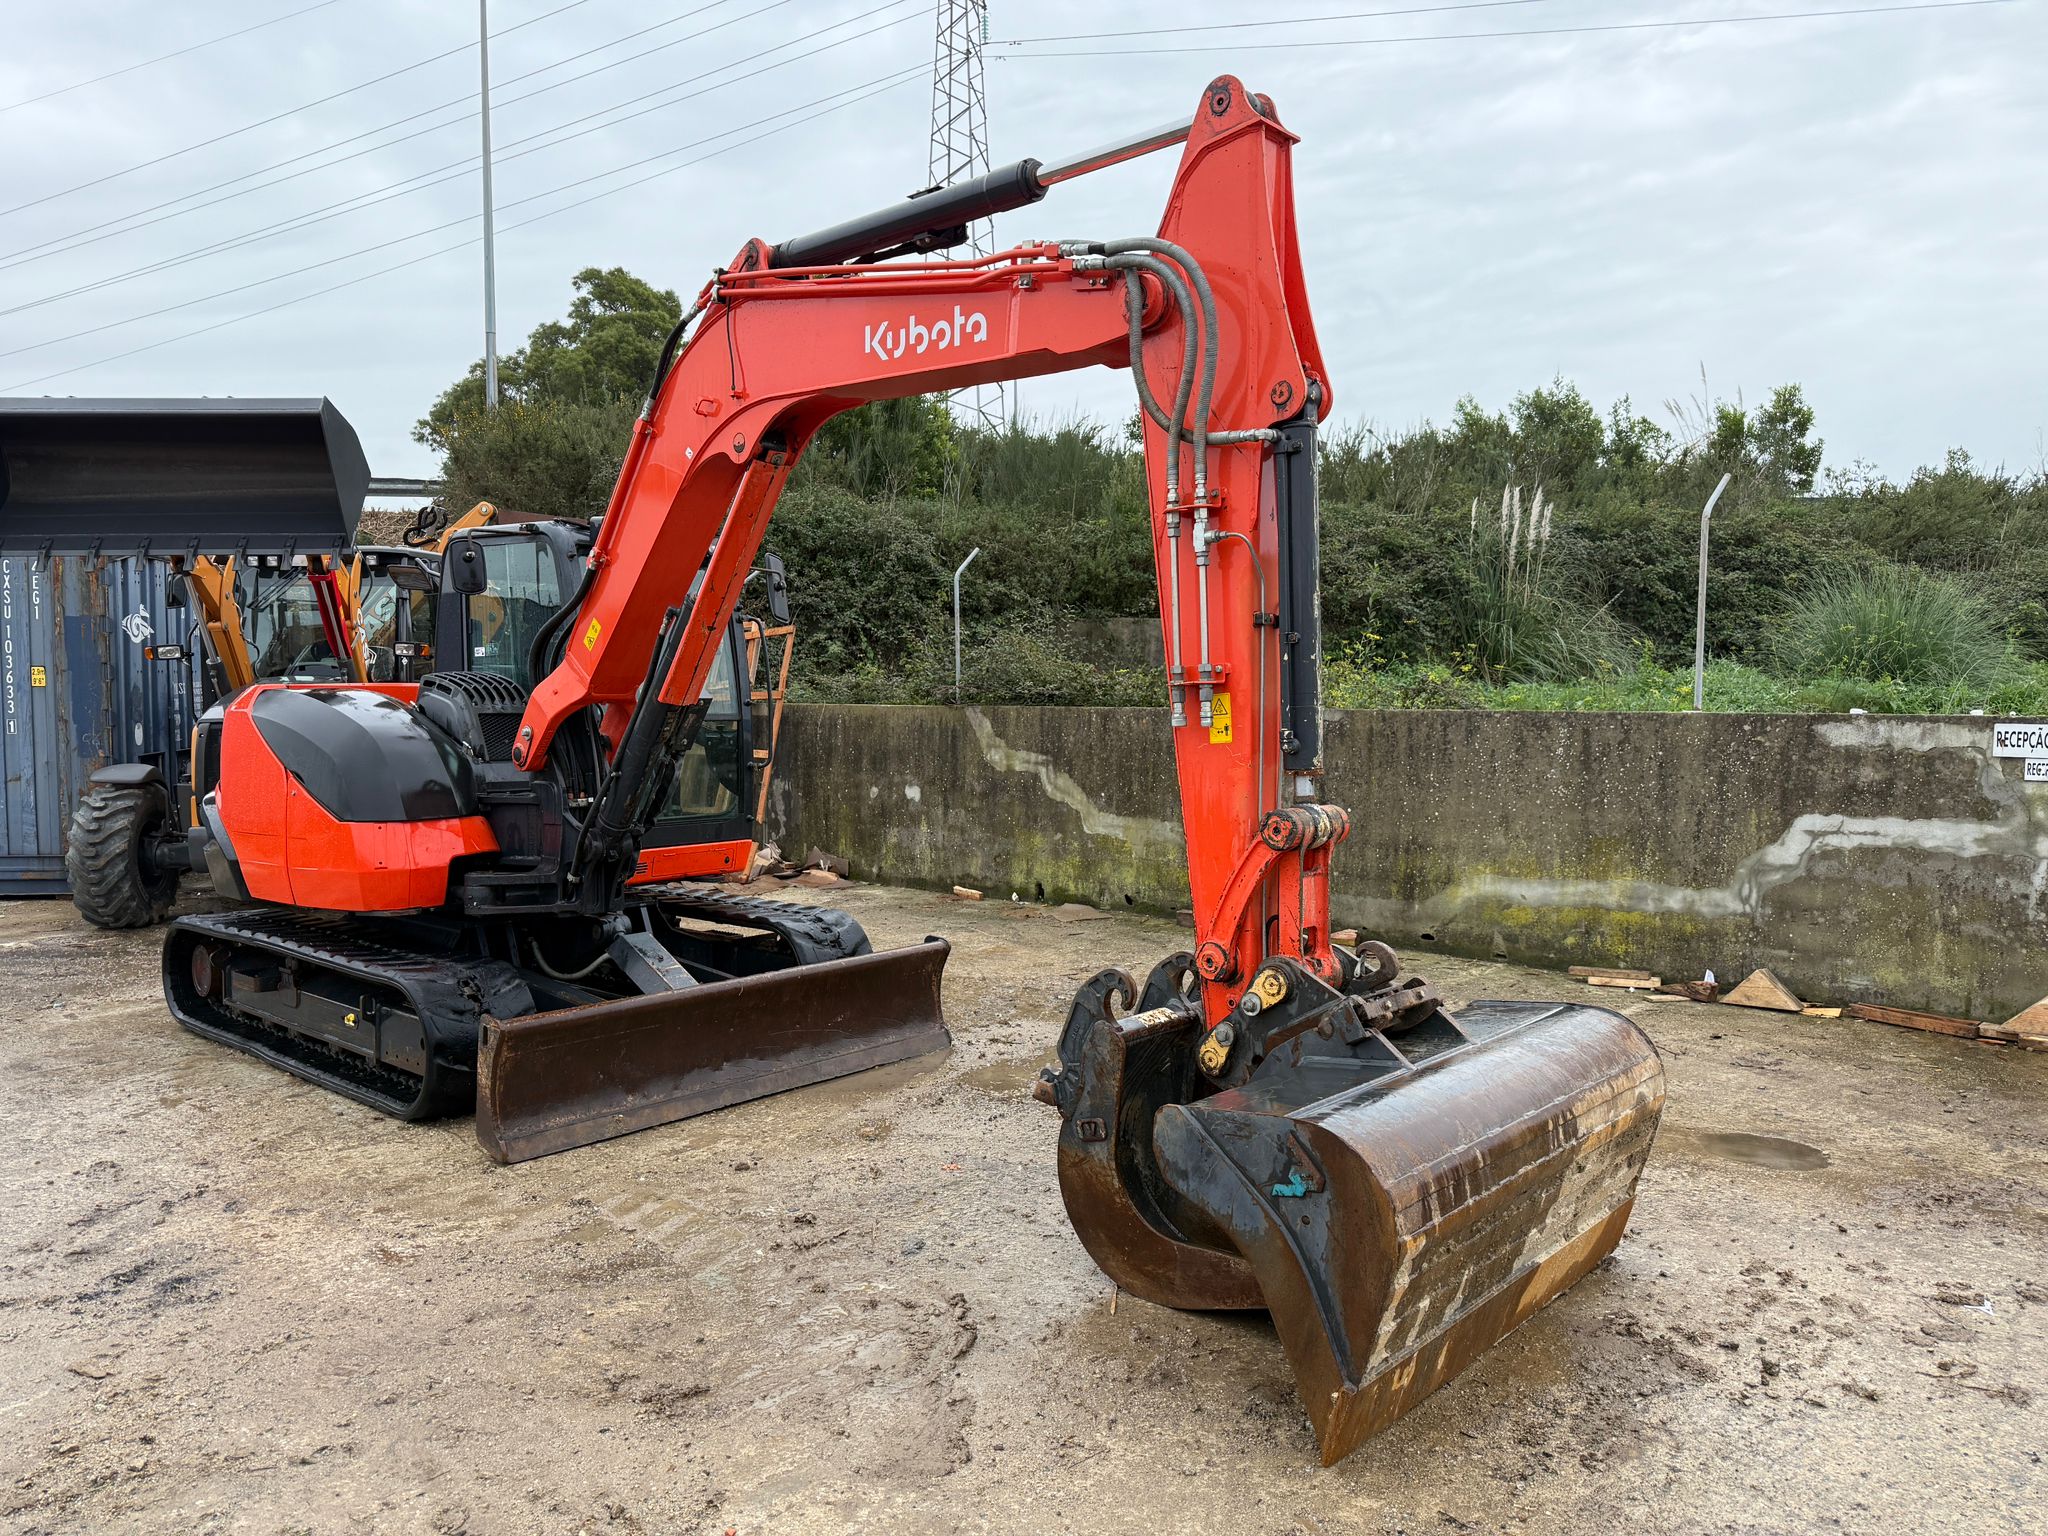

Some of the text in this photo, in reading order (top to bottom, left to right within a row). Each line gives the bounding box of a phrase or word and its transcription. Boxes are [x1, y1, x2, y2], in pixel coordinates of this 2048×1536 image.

[864, 304, 988, 361] Kubota
[2, 559, 12, 619] CXSU
[4, 625, 15, 714] 103633
